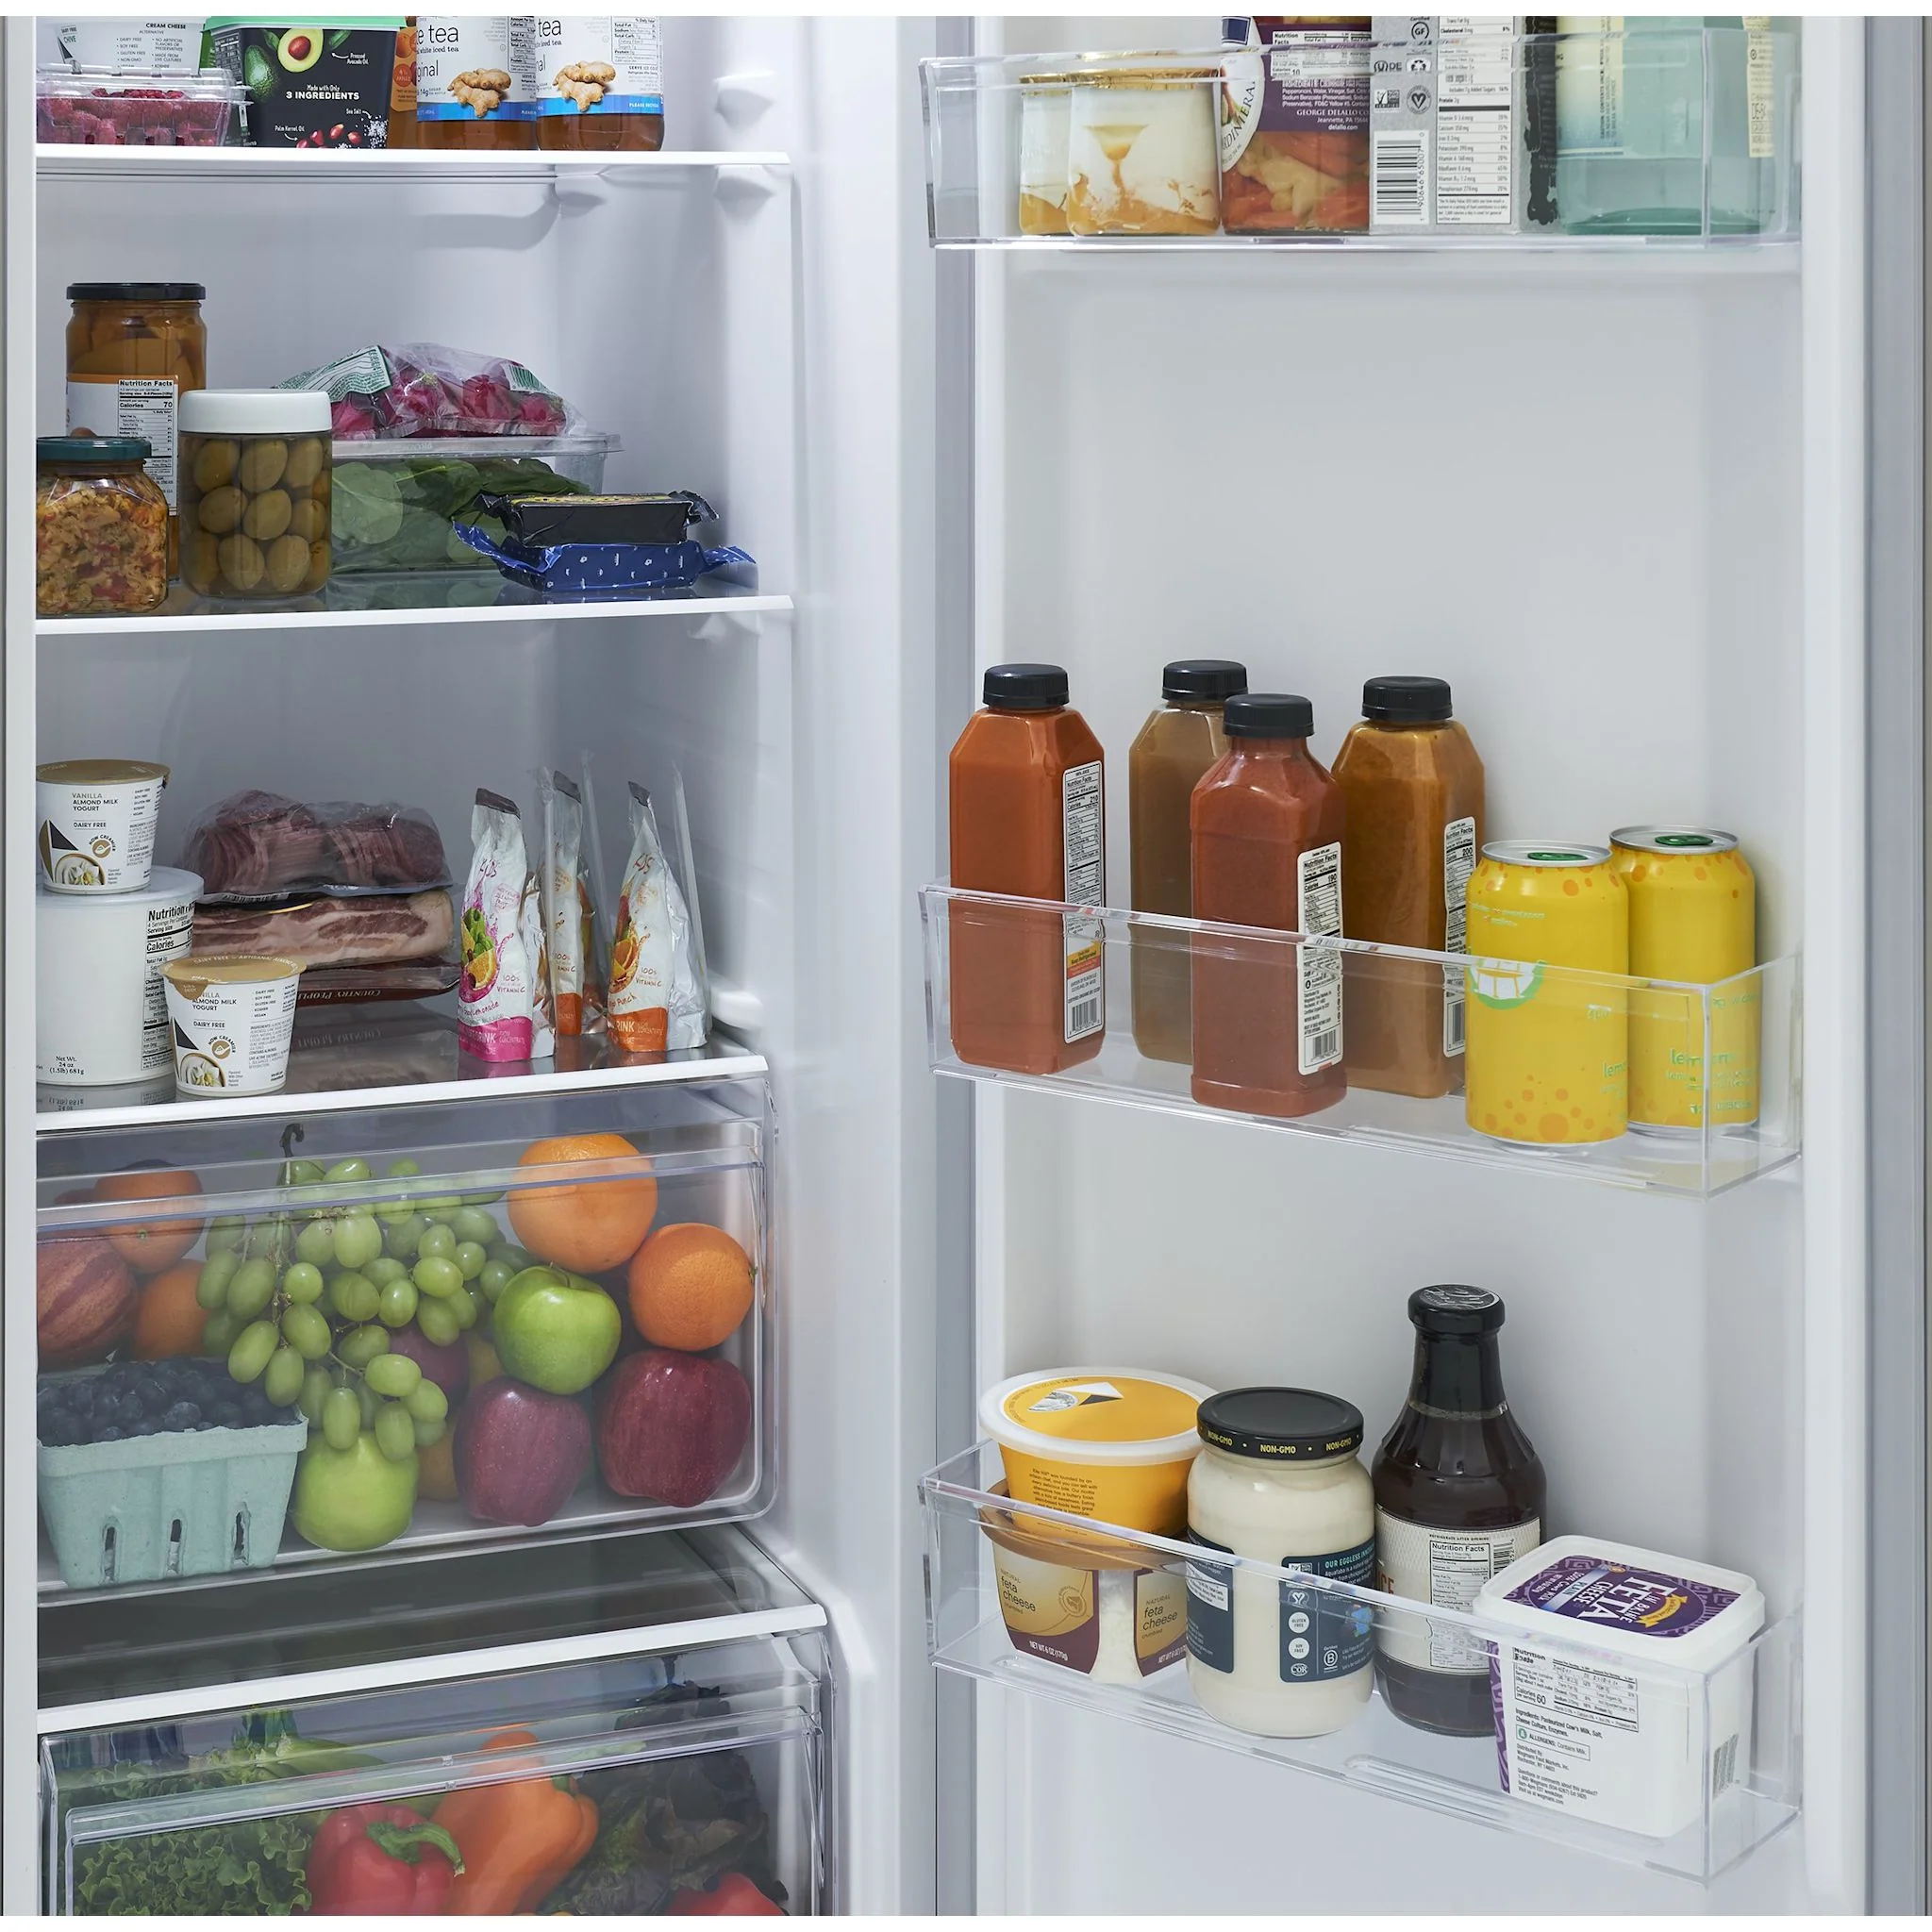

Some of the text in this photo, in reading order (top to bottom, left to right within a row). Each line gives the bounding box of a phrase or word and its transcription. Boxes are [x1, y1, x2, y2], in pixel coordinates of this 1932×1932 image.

[429, 25, 459, 43] tea
[538, 19, 561, 38] tea
[294, 92, 359, 100] INGREDIENTS
[148, 906, 185, 922] Nutrition
[146, 940, 175, 952] Calories
[69, 1067, 85, 1075] 681g
[1259, 1443, 1296, 1455] NON-GMO
[1325, 1437, 1352, 1452] NON-GMO
[1432, 1542, 1485, 1553] Nutrition Facts
[1324, 1559, 1339, 1569] OUR
[1001, 1575, 1018, 1593] feta
[1003, 1590, 1036, 1612] cheese
[1573, 1581, 1614, 1605] CHEESE
[1576, 1576, 1678, 1619] FETA
[1143, 1606, 1164, 1619] feta
[1142, 1611, 1178, 1632] cheese
[1516, 1686, 1546, 1706] Calories 60
